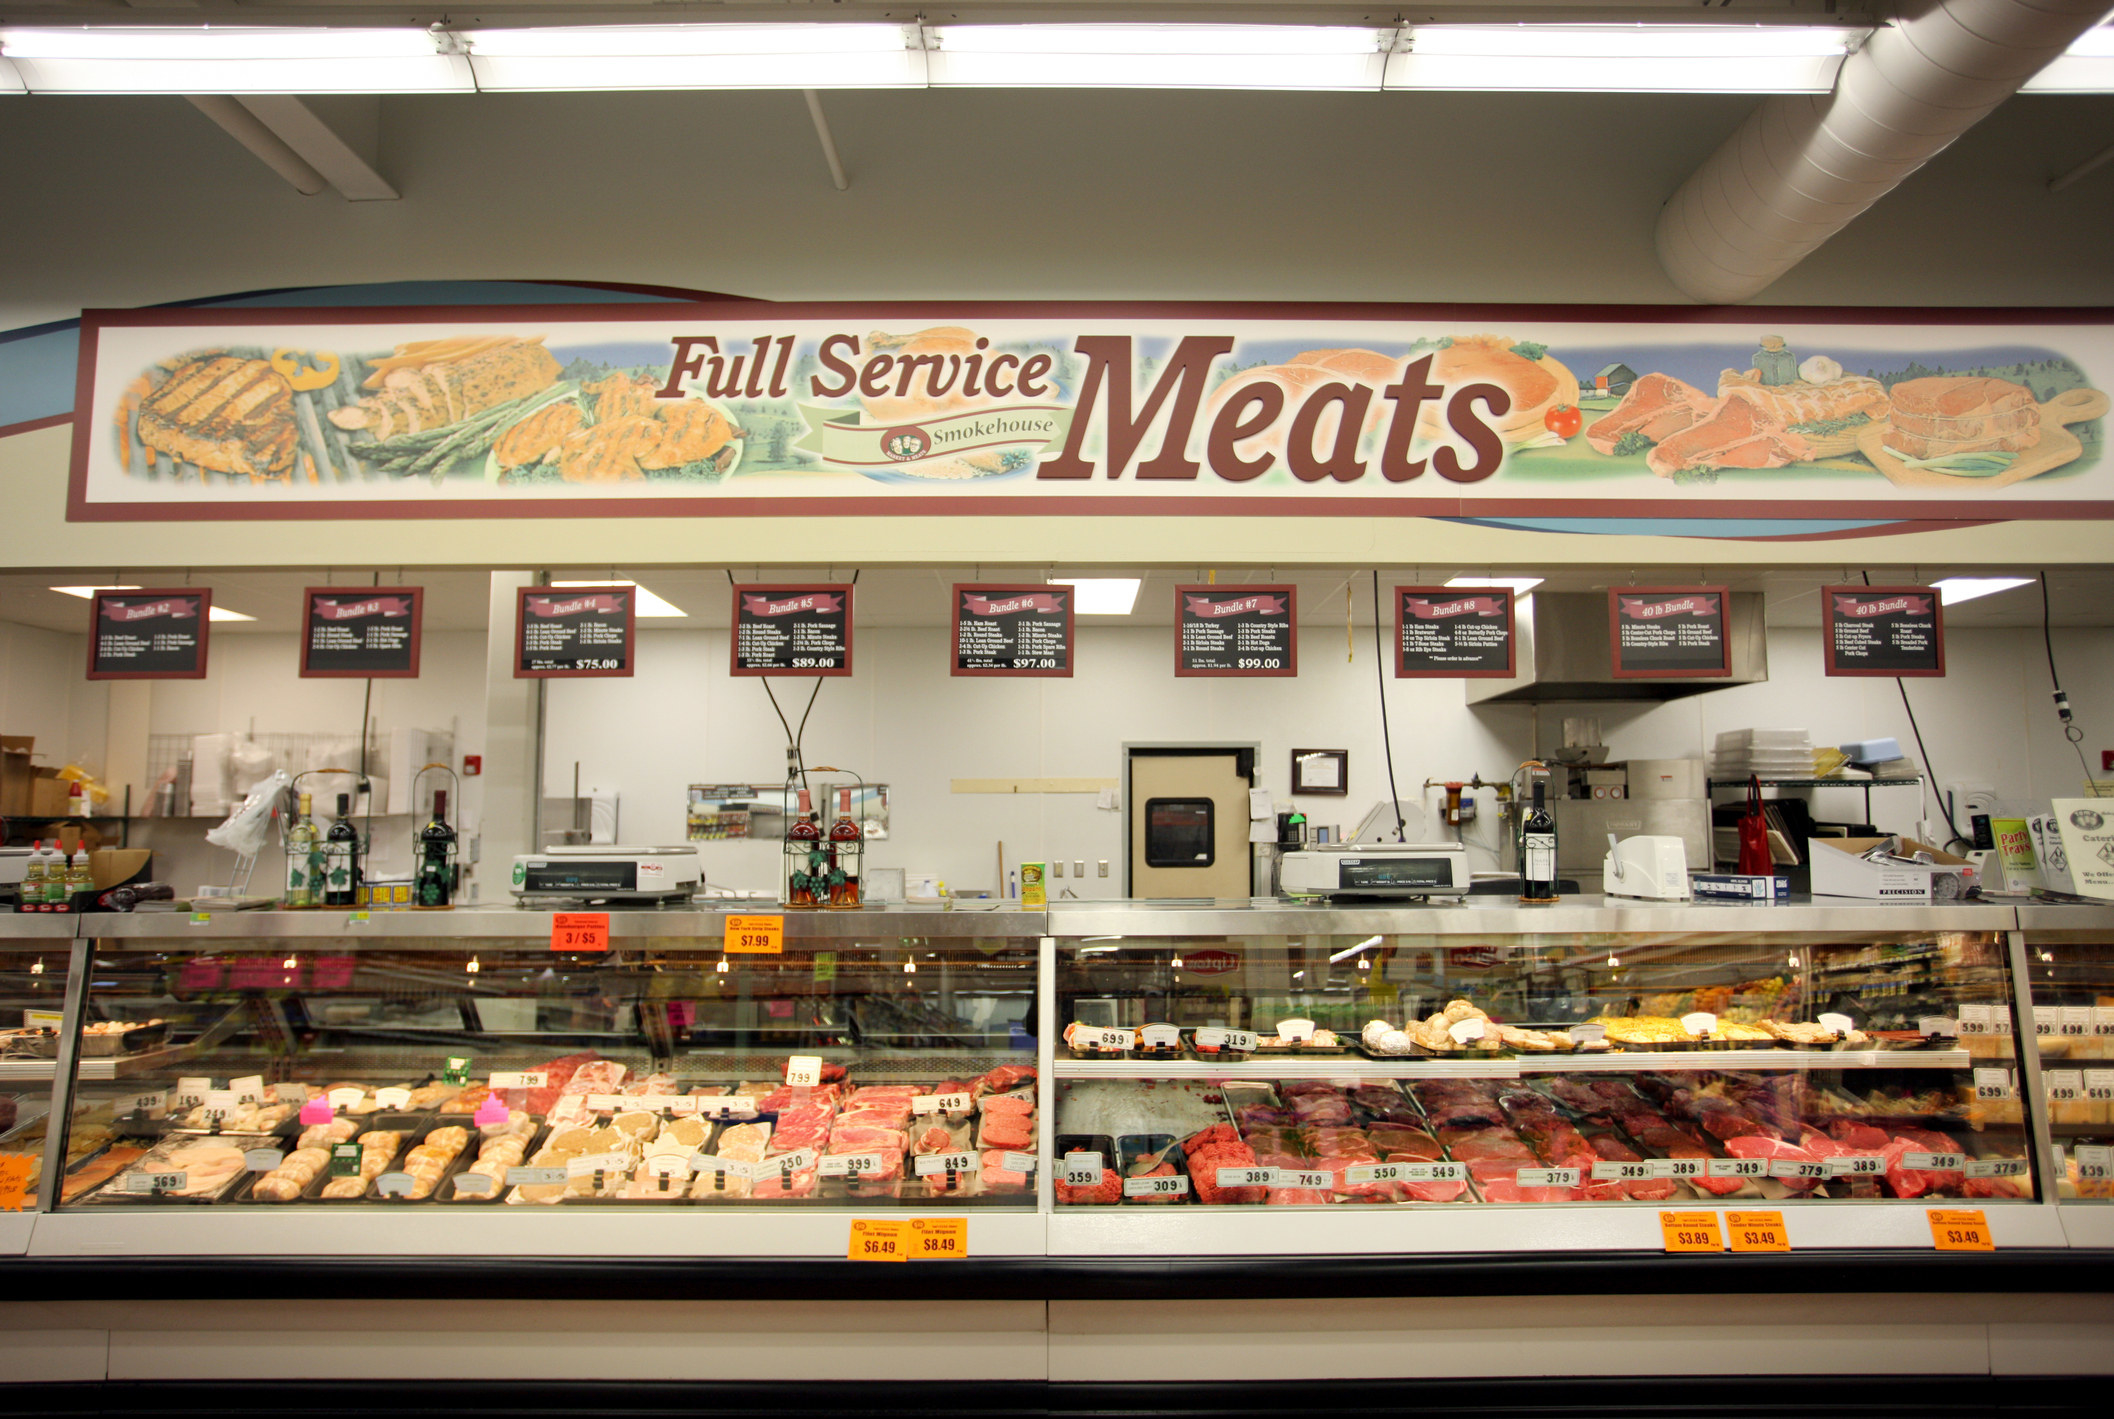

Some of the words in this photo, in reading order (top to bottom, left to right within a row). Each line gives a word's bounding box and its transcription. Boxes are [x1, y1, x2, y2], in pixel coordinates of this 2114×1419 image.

[655, 334, 796, 399] Full
[811, 333, 1051, 399] Service
[1036, 335, 1511, 482] Meats
[933, 417, 1054, 445] Smokehouse
[126, 607, 155, 619] Bundle
[158, 603, 170, 613] #2
[336, 605, 365, 618] Bundle
[367, 602, 379, 612] #3
[552, 601, 582, 614] Bundle
[584, 599, 596, 608] #4
[768, 601, 798, 614] Bundle
[801, 598, 813, 608] #5
[989, 601, 1019, 613] Bundle
[1022, 599, 1033, 607] #6
[1214, 602, 1243, 614] Bundle
[1246, 599, 1257, 609] #7
[1432, 604, 1461, 616] Bundle
[1464, 601, 1475, 610] #8
[1642, 607, 1653, 616] 40
[1655, 606, 1662, 615] lb
[1665, 600, 1694, 613] Bundle
[1856, 606, 1867, 615] 40
[1869, 605, 1876, 613] lb
[1879, 599, 1908, 612] Bundle
[576, 659, 618, 669] $75.00
[792, 658, 834, 668] $89.00
[1013, 659, 1055, 668] $97.00
[1238, 658, 1280, 668] $99.00
[2000, 831, 2028, 845] Party
[2001, 842, 2032, 856] Trays
[566, 932, 572, 944] 3
[574, 932, 580, 944] /
[582, 932, 595, 944] $5
[741, 934, 769, 947] $7.99
[1678, 1231, 1709, 1245] $3.89
[1744, 1231, 1775, 1245] $3.49
[1947, 1230, 1980, 1243] $3.49
[864, 1240, 896, 1254] $6.49
[924, 1238, 955, 1251] $8.49
